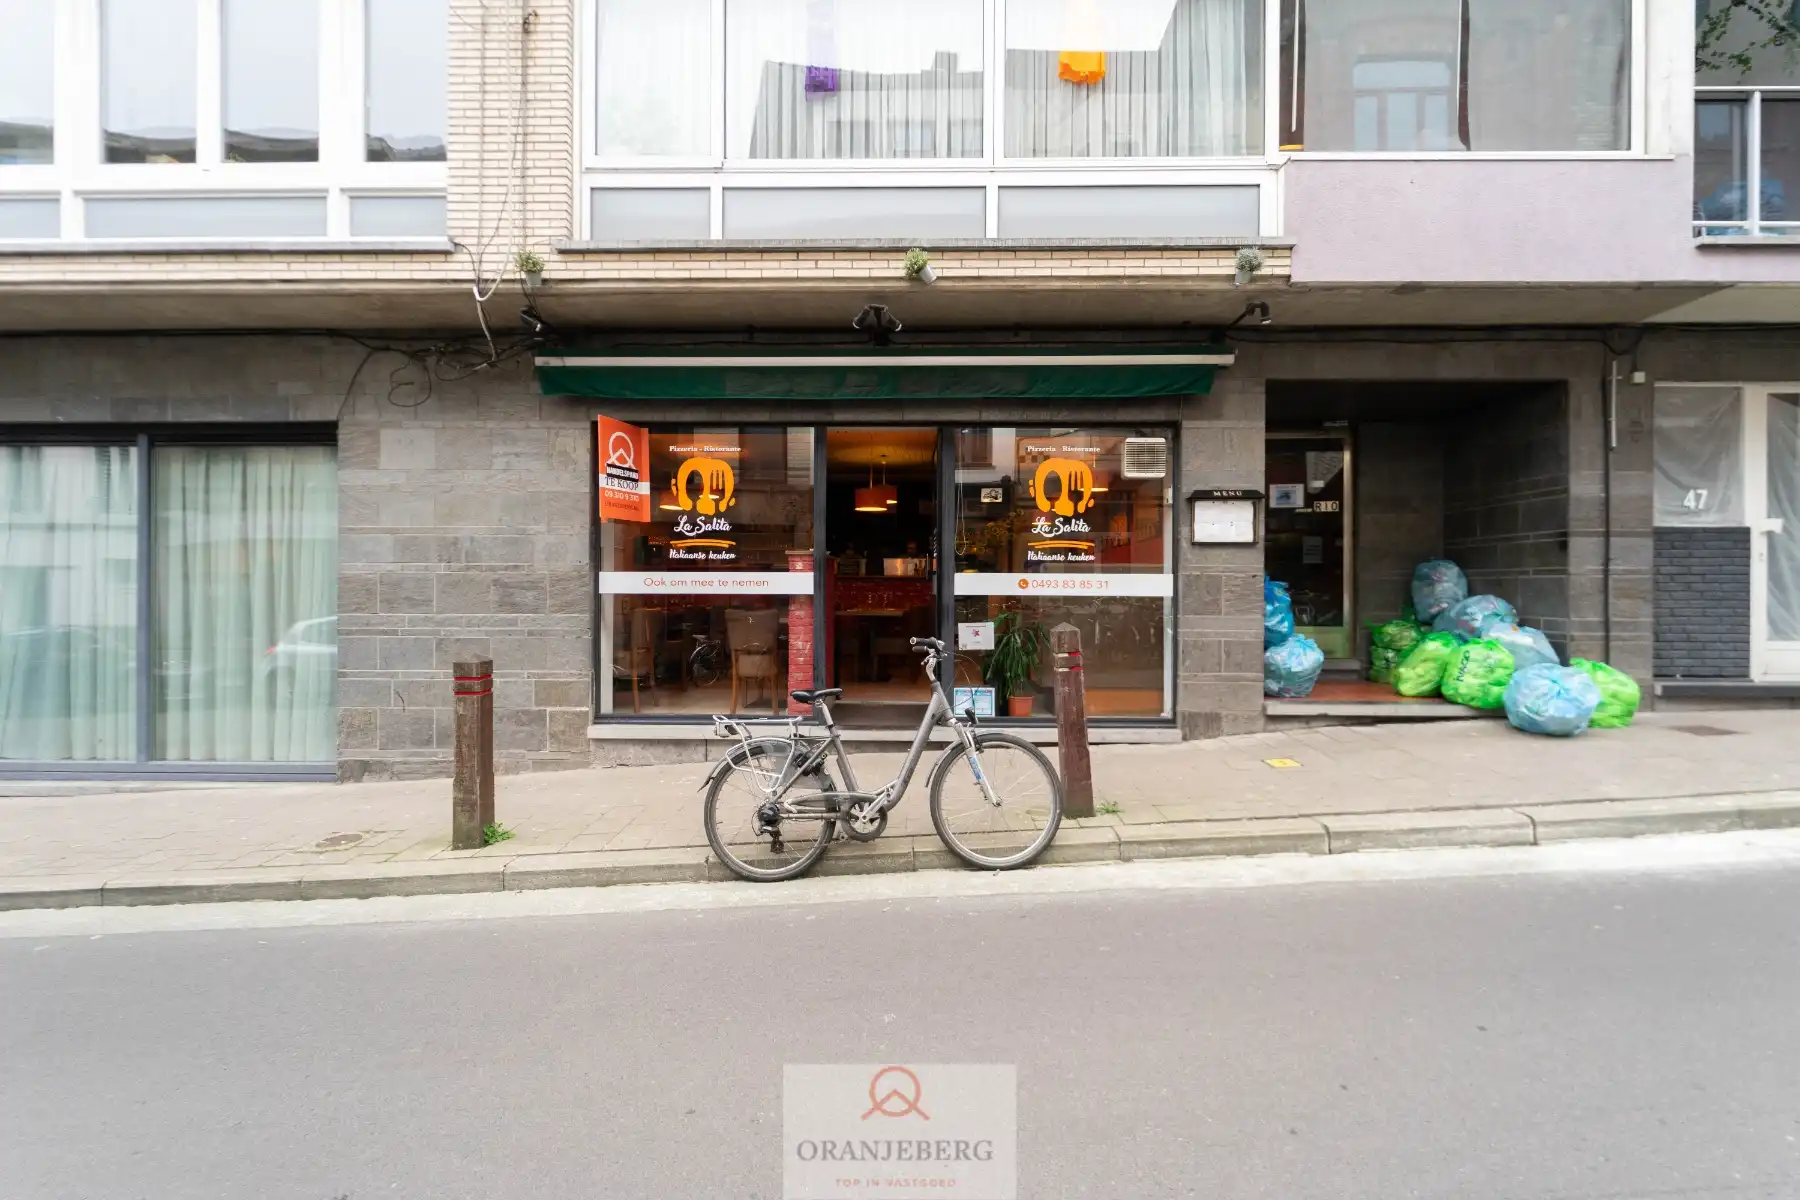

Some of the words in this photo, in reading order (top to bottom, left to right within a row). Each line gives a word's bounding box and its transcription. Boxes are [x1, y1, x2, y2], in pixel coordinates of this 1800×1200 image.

[1062, 445, 1101, 453] Ristorante
[605, 477, 615, 486] TE
[617, 480, 639, 490] KOOP
[1683, 488, 1708, 510] 47
[1315, 501, 1338, 511] RIO
[674, 515, 696, 536] La
[695, 516, 732, 533] Salita
[1031, 517, 1054, 537] La
[1053, 517, 1091, 535] Salita
[669, 548, 707, 560] Italiaanse
[708, 550, 737, 560] keuken
[1027, 550, 1066, 562] Italiaanse
[1067, 552, 1096, 562] keuken
[643, 577, 667, 587] Ook
[669, 579, 688, 587] om
[690, 579, 715, 587] mee
[717, 578, 729, 587] te
[731, 579, 769, 587] nemen
[1031, 579, 1059, 589] 0493
[1062, 579, 1076, 589] 83
[1079, 580, 1093, 589] 85
[1096, 580, 1109, 589] 31
